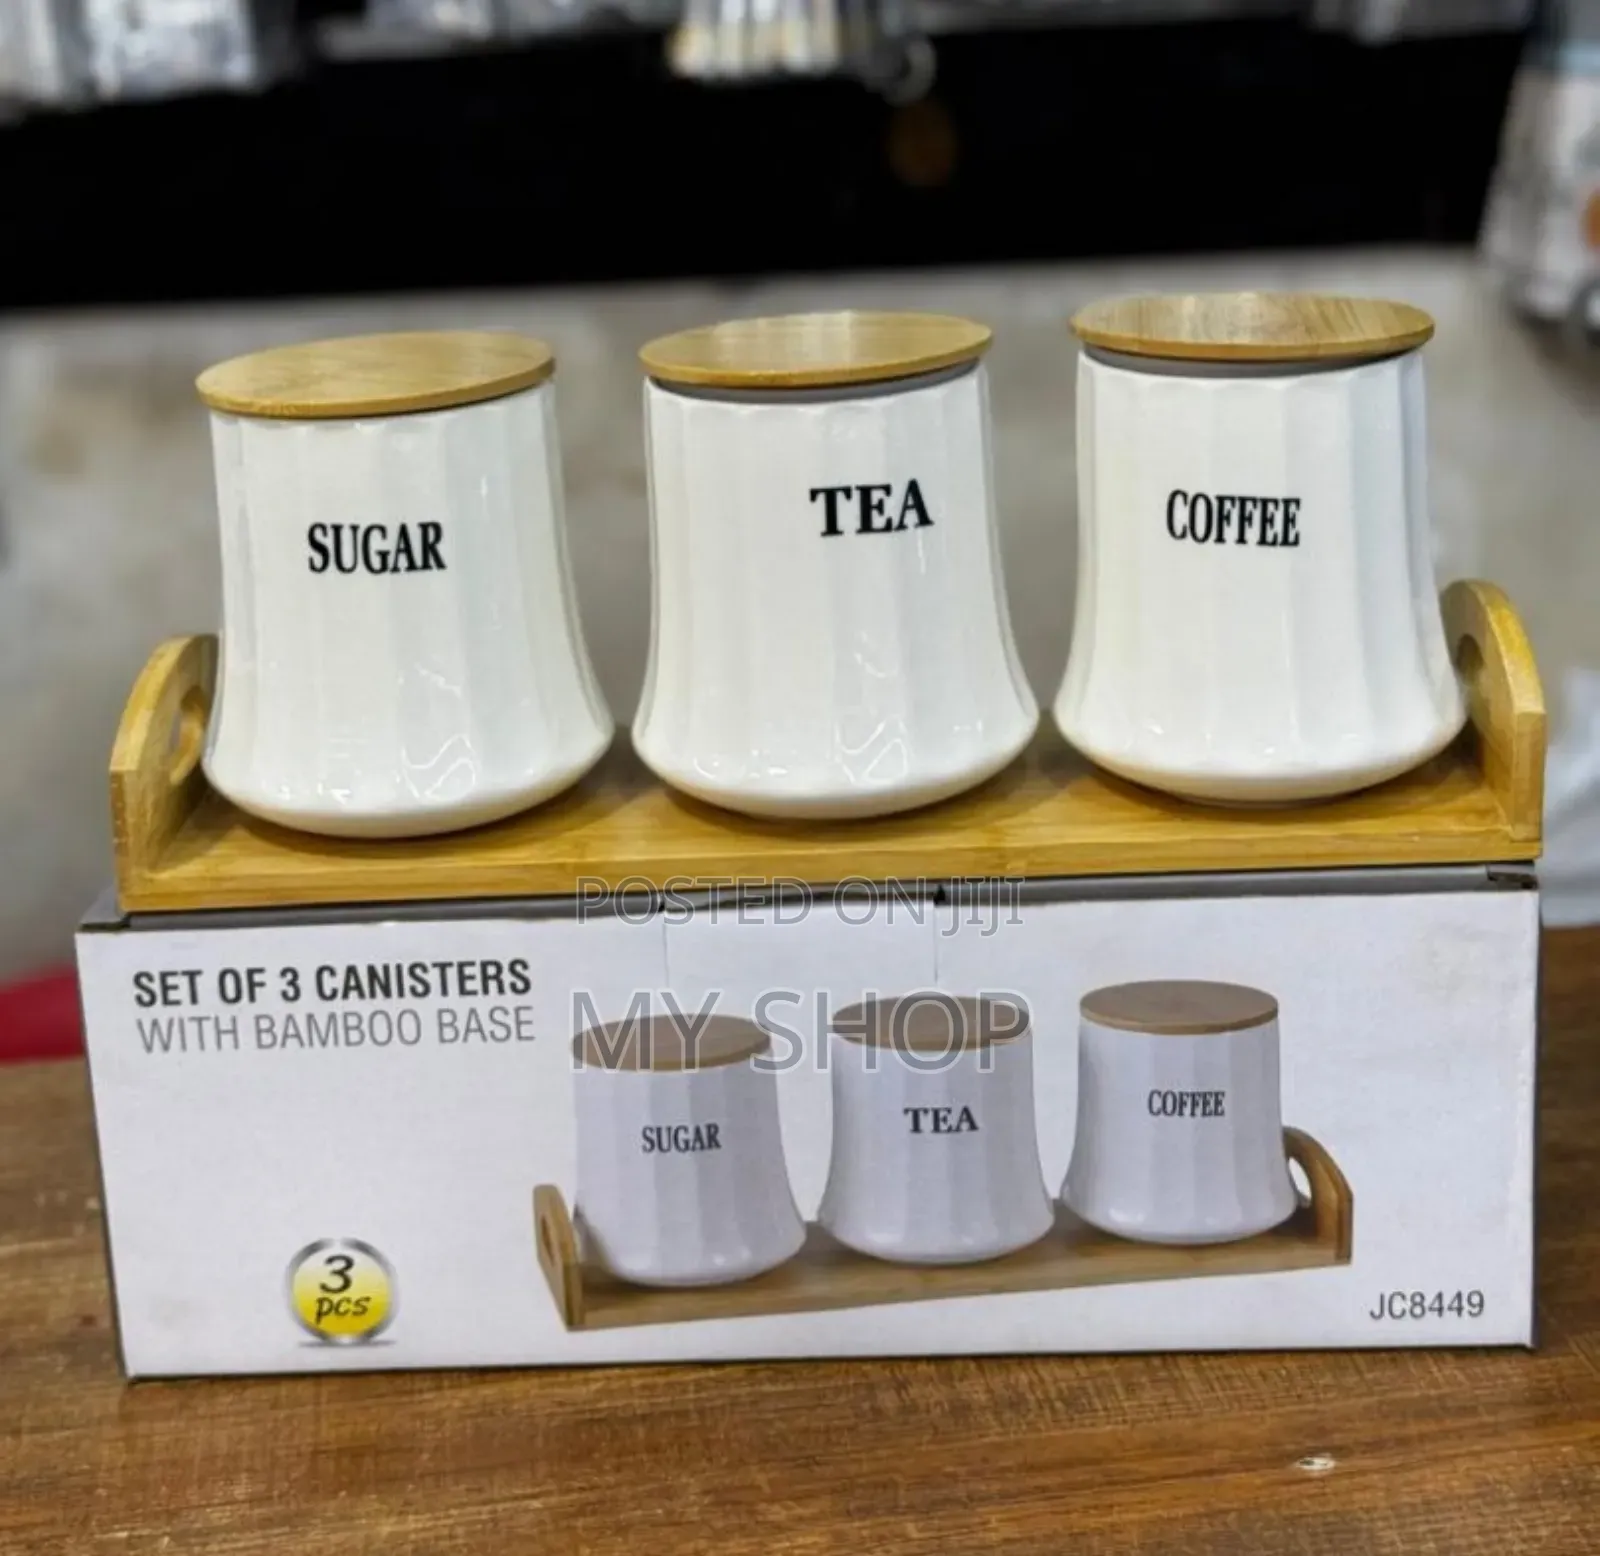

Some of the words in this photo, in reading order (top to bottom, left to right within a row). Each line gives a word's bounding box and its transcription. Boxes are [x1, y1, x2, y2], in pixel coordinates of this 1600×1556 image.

[810, 479, 934, 536] TEA
[1167, 489, 1302, 547] COFFEE
[307, 521, 447, 574] SUGAR
[134, 970, 203, 1008] SET
[218, 968, 266, 1004] OF
[279, 967, 302, 1002] 3
[315, 959, 532, 1001] CANISTERS
[137, 1015, 240, 1053] WITH
[254, 1009, 422, 1049] BAMBOO
[436, 1006, 536, 1044] BASE
[903, 1105, 980, 1134] TEA
[1147, 1089, 1226, 1118] COFFEE
[642, 1122, 723, 1153] SUGAR
[319, 1254, 354, 1294] 3
[315, 1295, 371, 1325] pcs
[1369, 1289, 1485, 1321] JC8449
